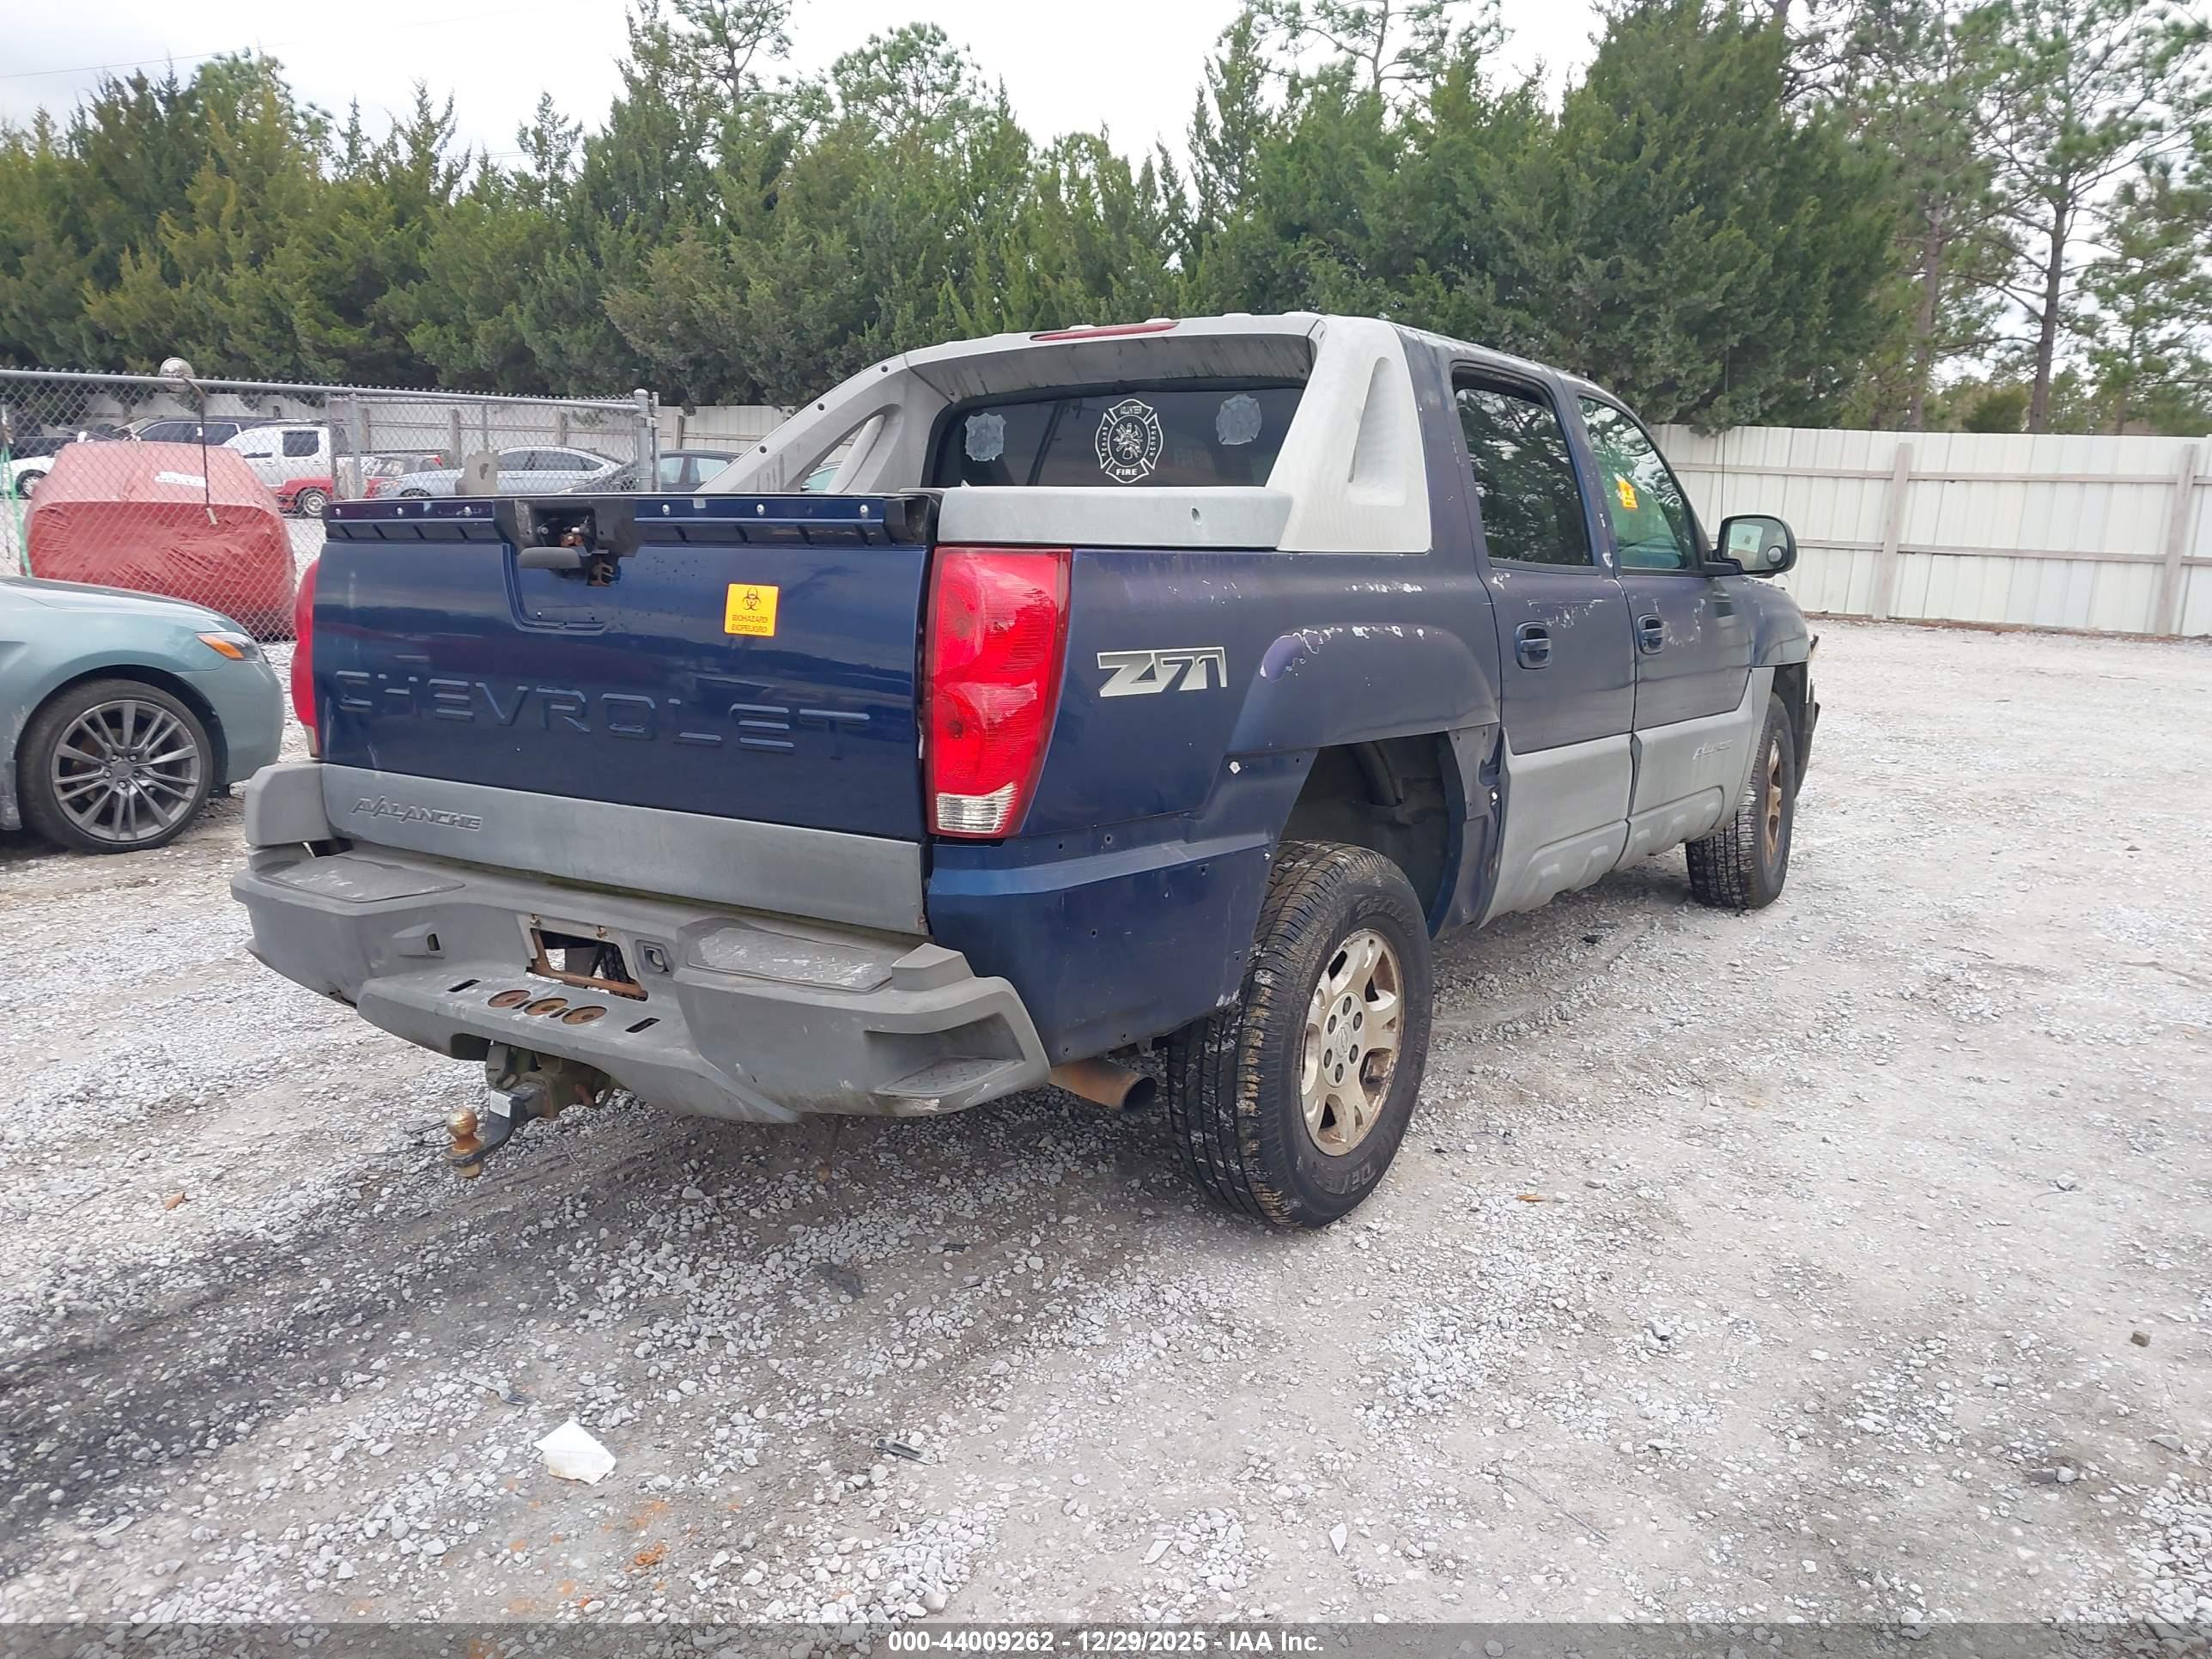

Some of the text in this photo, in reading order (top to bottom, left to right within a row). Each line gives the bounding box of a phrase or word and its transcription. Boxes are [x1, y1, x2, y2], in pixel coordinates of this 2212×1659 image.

[732, 614, 769, 623] BIOHAZARD
[1097, 646, 1228, 697] Z71
[335, 670, 871, 760] CHEVROLET
[349, 795, 483, 831] AVALANCHE
